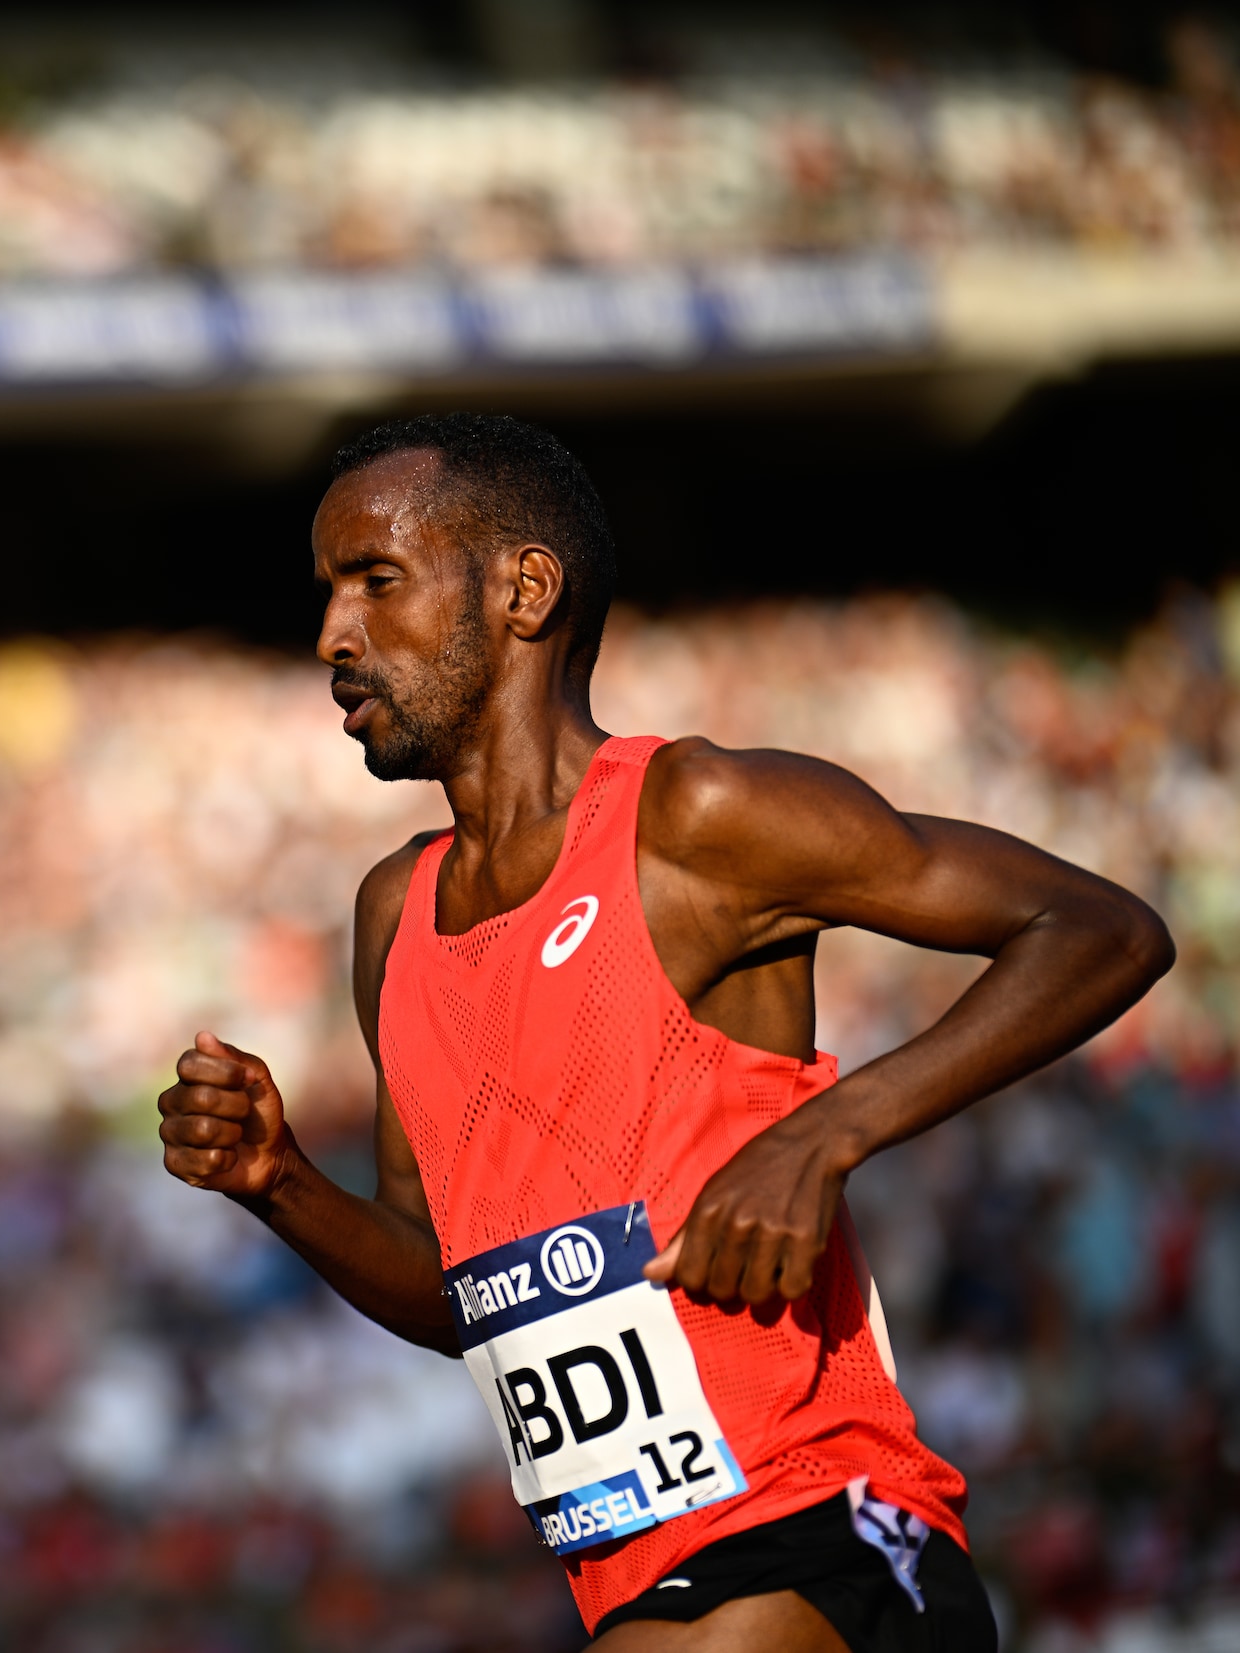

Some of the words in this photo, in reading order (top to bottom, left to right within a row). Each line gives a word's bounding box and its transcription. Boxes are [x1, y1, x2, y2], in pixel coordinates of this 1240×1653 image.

[454, 1262, 540, 1325] Allianz
[495, 1328, 664, 1467] ABDI
[639, 1430, 715, 1494] 12
